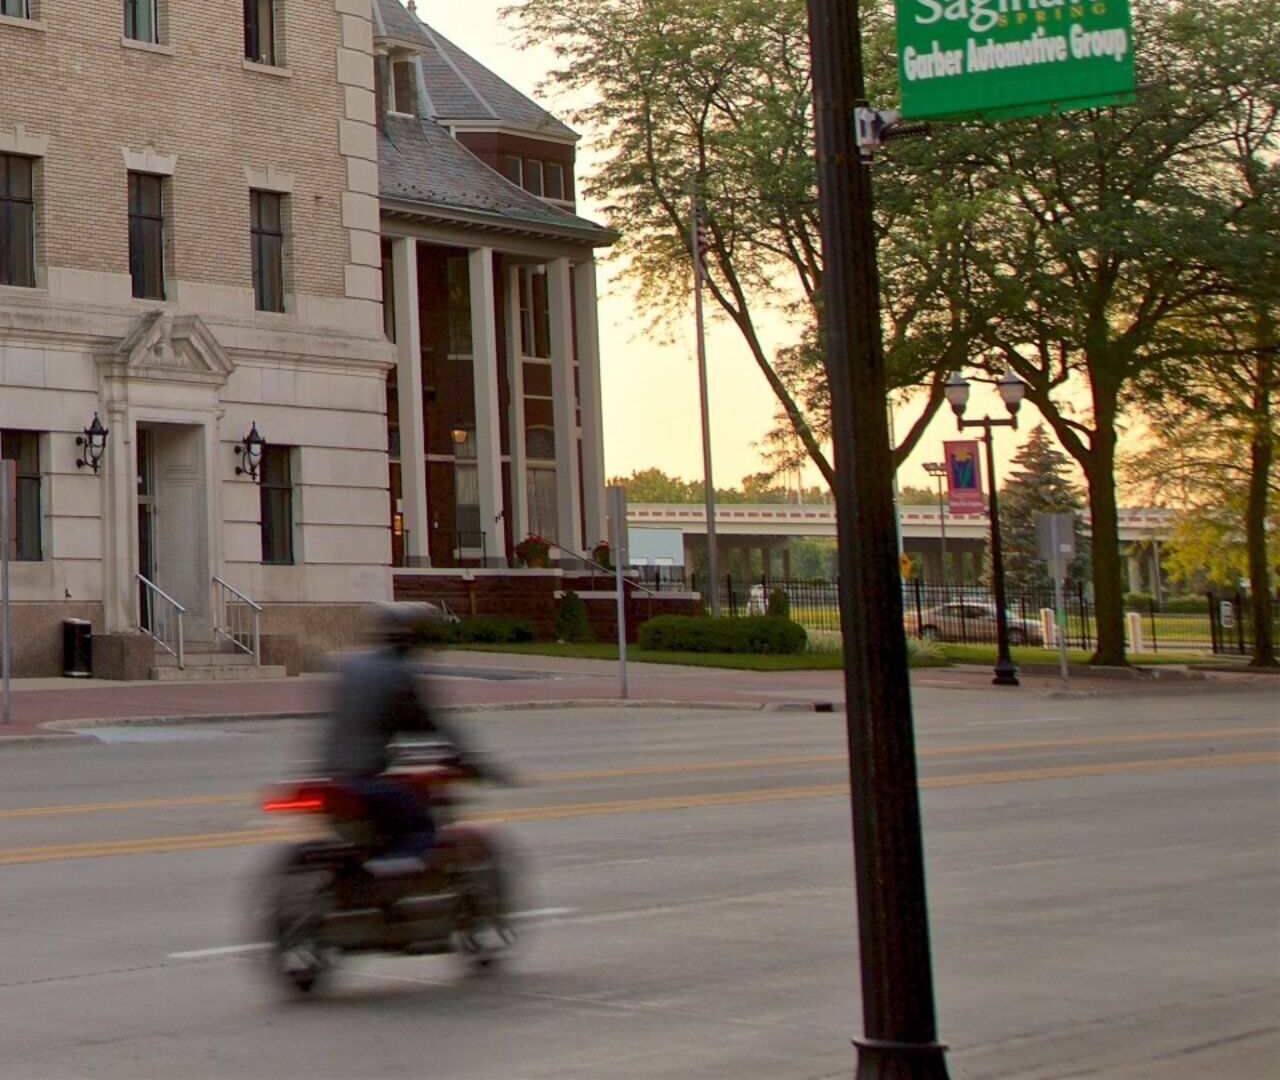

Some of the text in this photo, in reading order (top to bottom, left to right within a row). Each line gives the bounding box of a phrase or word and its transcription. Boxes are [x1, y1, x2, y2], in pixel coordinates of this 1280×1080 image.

[997, 2, 1108, 28] SPRING
[903, 22, 1128, 82] Garber Automotive Group
